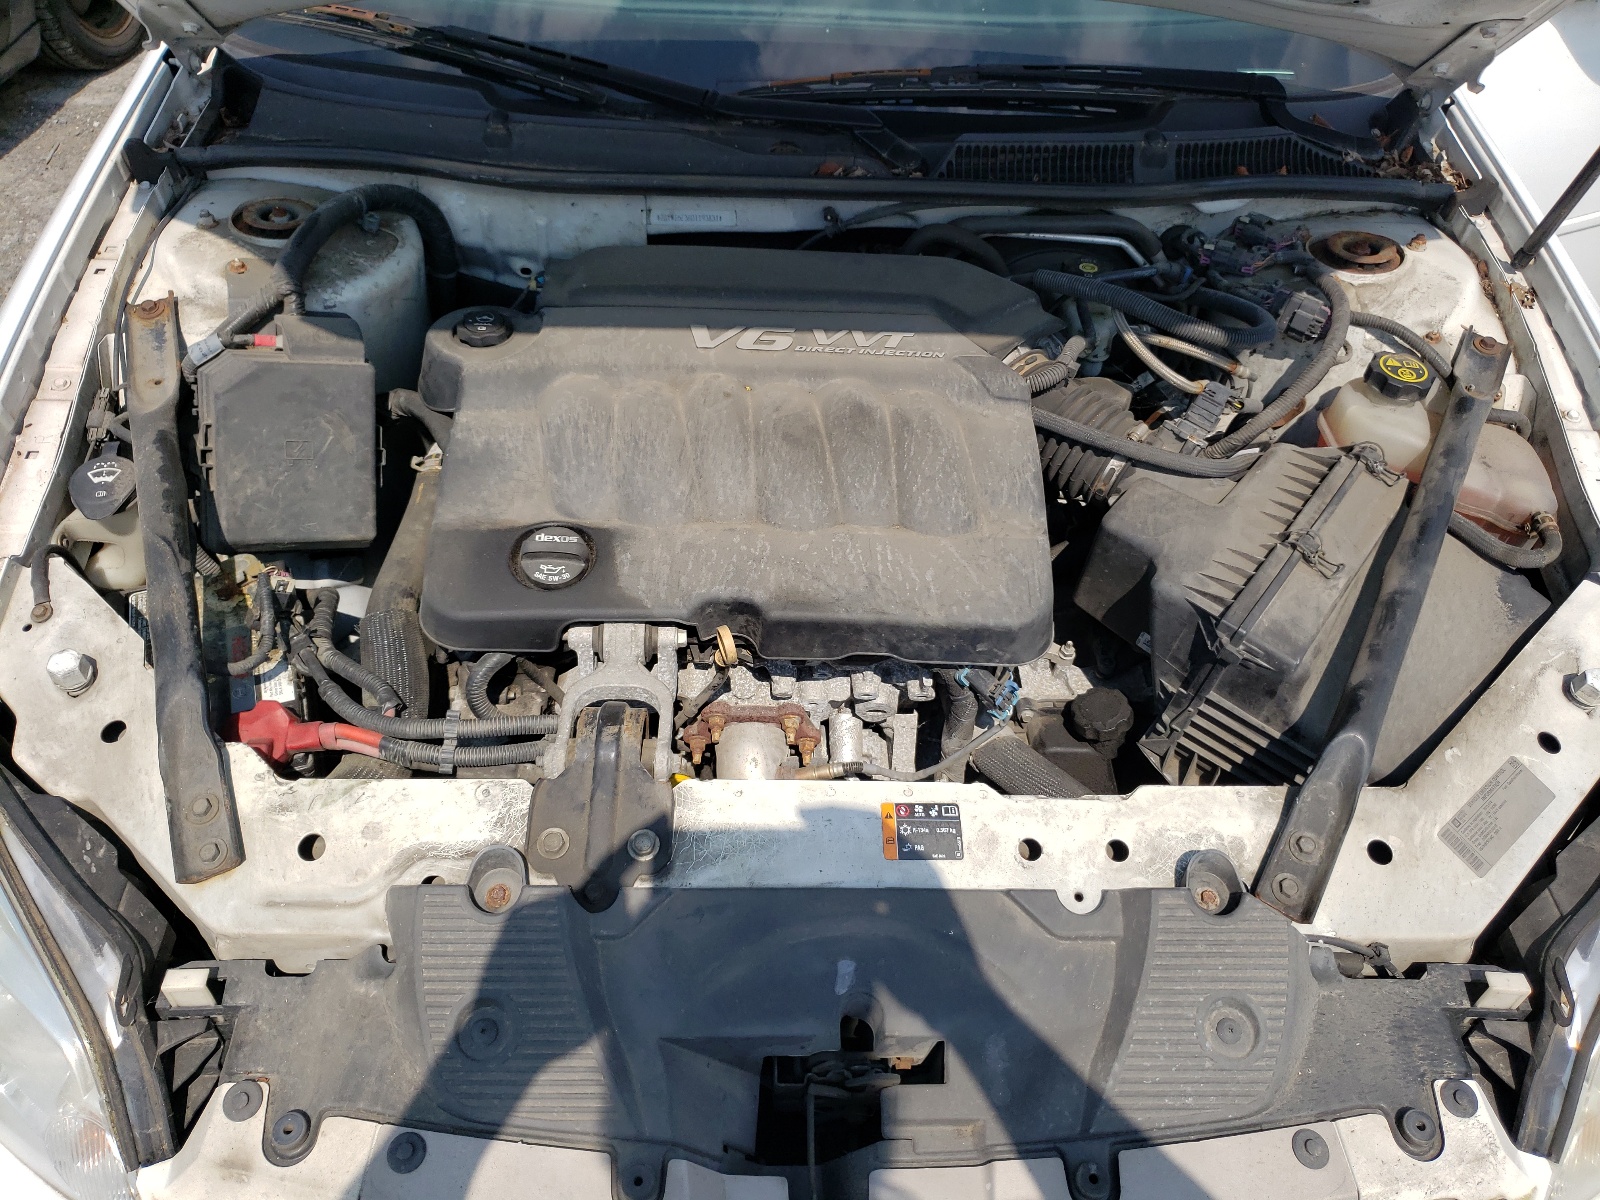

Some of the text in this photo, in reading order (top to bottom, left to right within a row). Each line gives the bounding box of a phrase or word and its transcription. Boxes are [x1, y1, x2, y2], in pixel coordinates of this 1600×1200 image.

[690, 325, 915, 350] V6 VVT
[794, 345, 946, 358] DIRECT INJECTION
[535, 533, 579, 543] dexos
[534, 571, 547, 580] SAE
